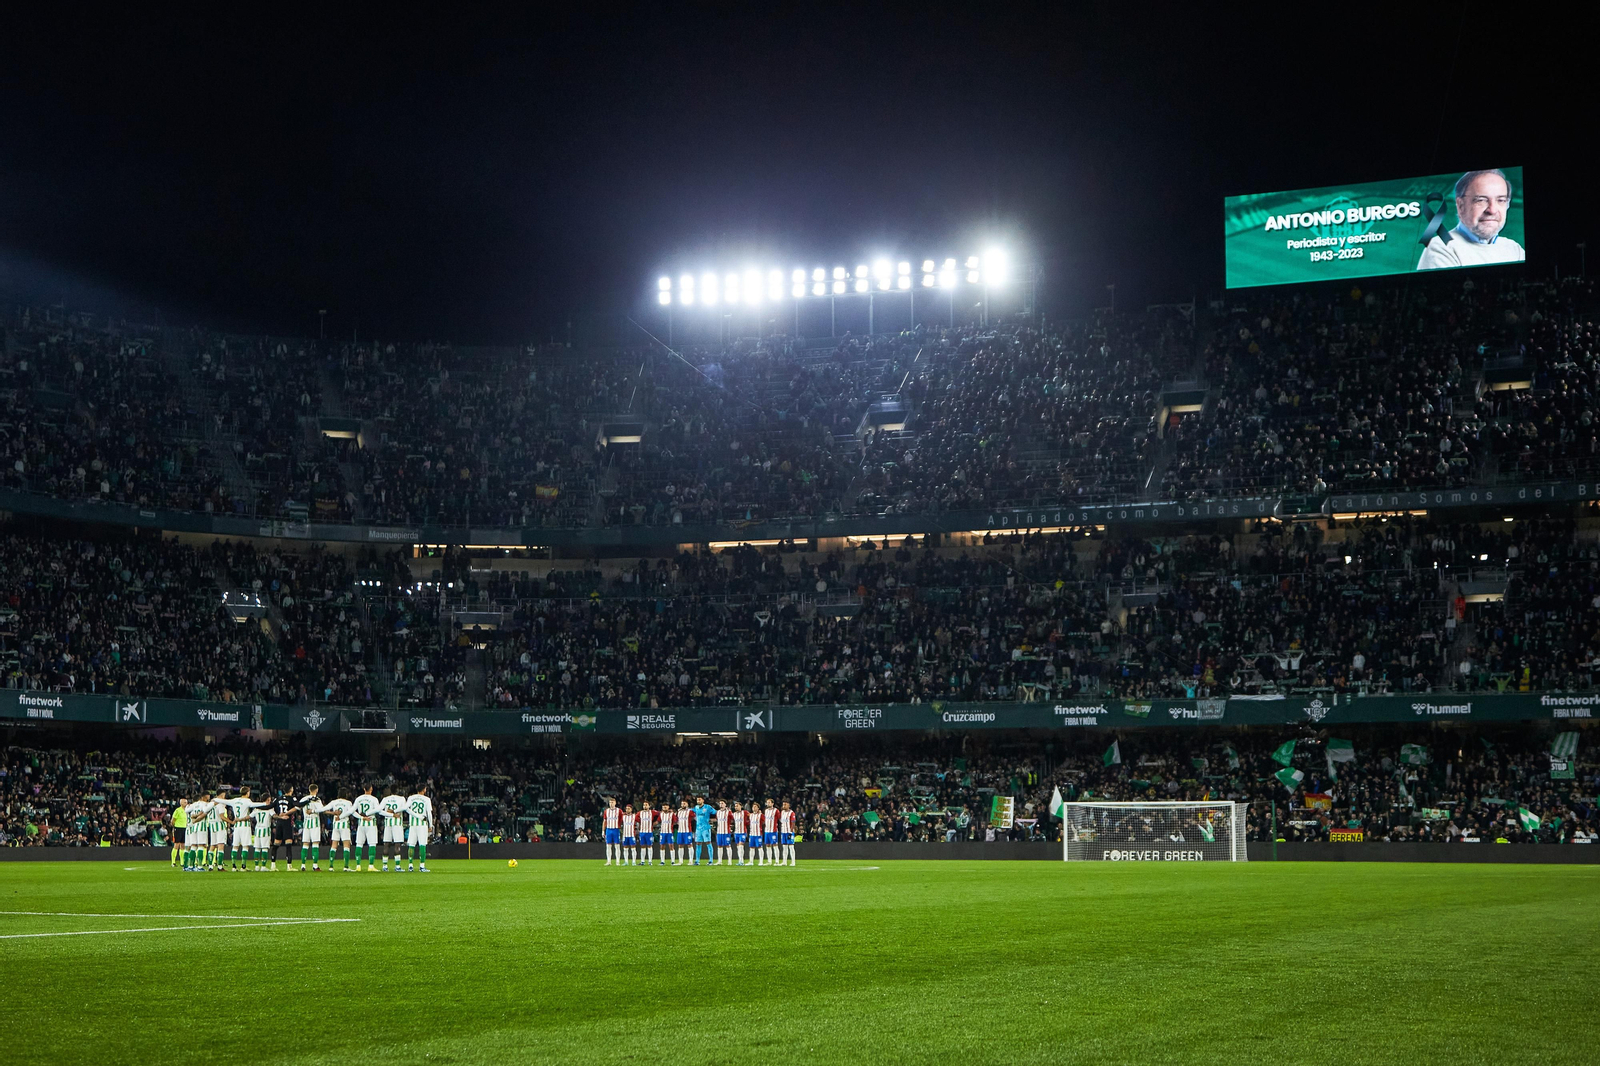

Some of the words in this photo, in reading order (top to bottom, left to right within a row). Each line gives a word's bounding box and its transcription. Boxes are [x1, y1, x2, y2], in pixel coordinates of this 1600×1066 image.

[1265, 209, 1344, 231] ANTONIO
[1347, 201, 1420, 223] BURGOS
[1287, 236, 1338, 250] Periodista
[1339, 237, 1346, 247] y
[1347, 231, 1386, 244] escritor
[1310, 247, 1363, 262] 1943-2023
[987, 511, 1089, 526] Apiñados
[1106, 508, 1159, 520] como
[1178, 505, 1239, 516] balas
[1518, 485, 1555, 499] del
[368, 530, 419, 540] Manquepierda
[19, 694, 63, 707] finetwork
[1427, 702, 1471, 714] hummel
[207, 711, 239, 722] hummel
[521, 713, 573, 723] finetwork
[641, 714, 676, 723] REALE
[942, 711, 996, 723] Cruzcampo
[423, 717, 462, 729] hummel
[845, 719, 875, 728] GREEN
[360, 803, 370, 815] 12
[411, 801, 425, 814] 28
[258, 812, 266, 823] 17
[1103, 850, 1160, 861] FOREVER
[1164, 850, 1204, 861] GREEN
